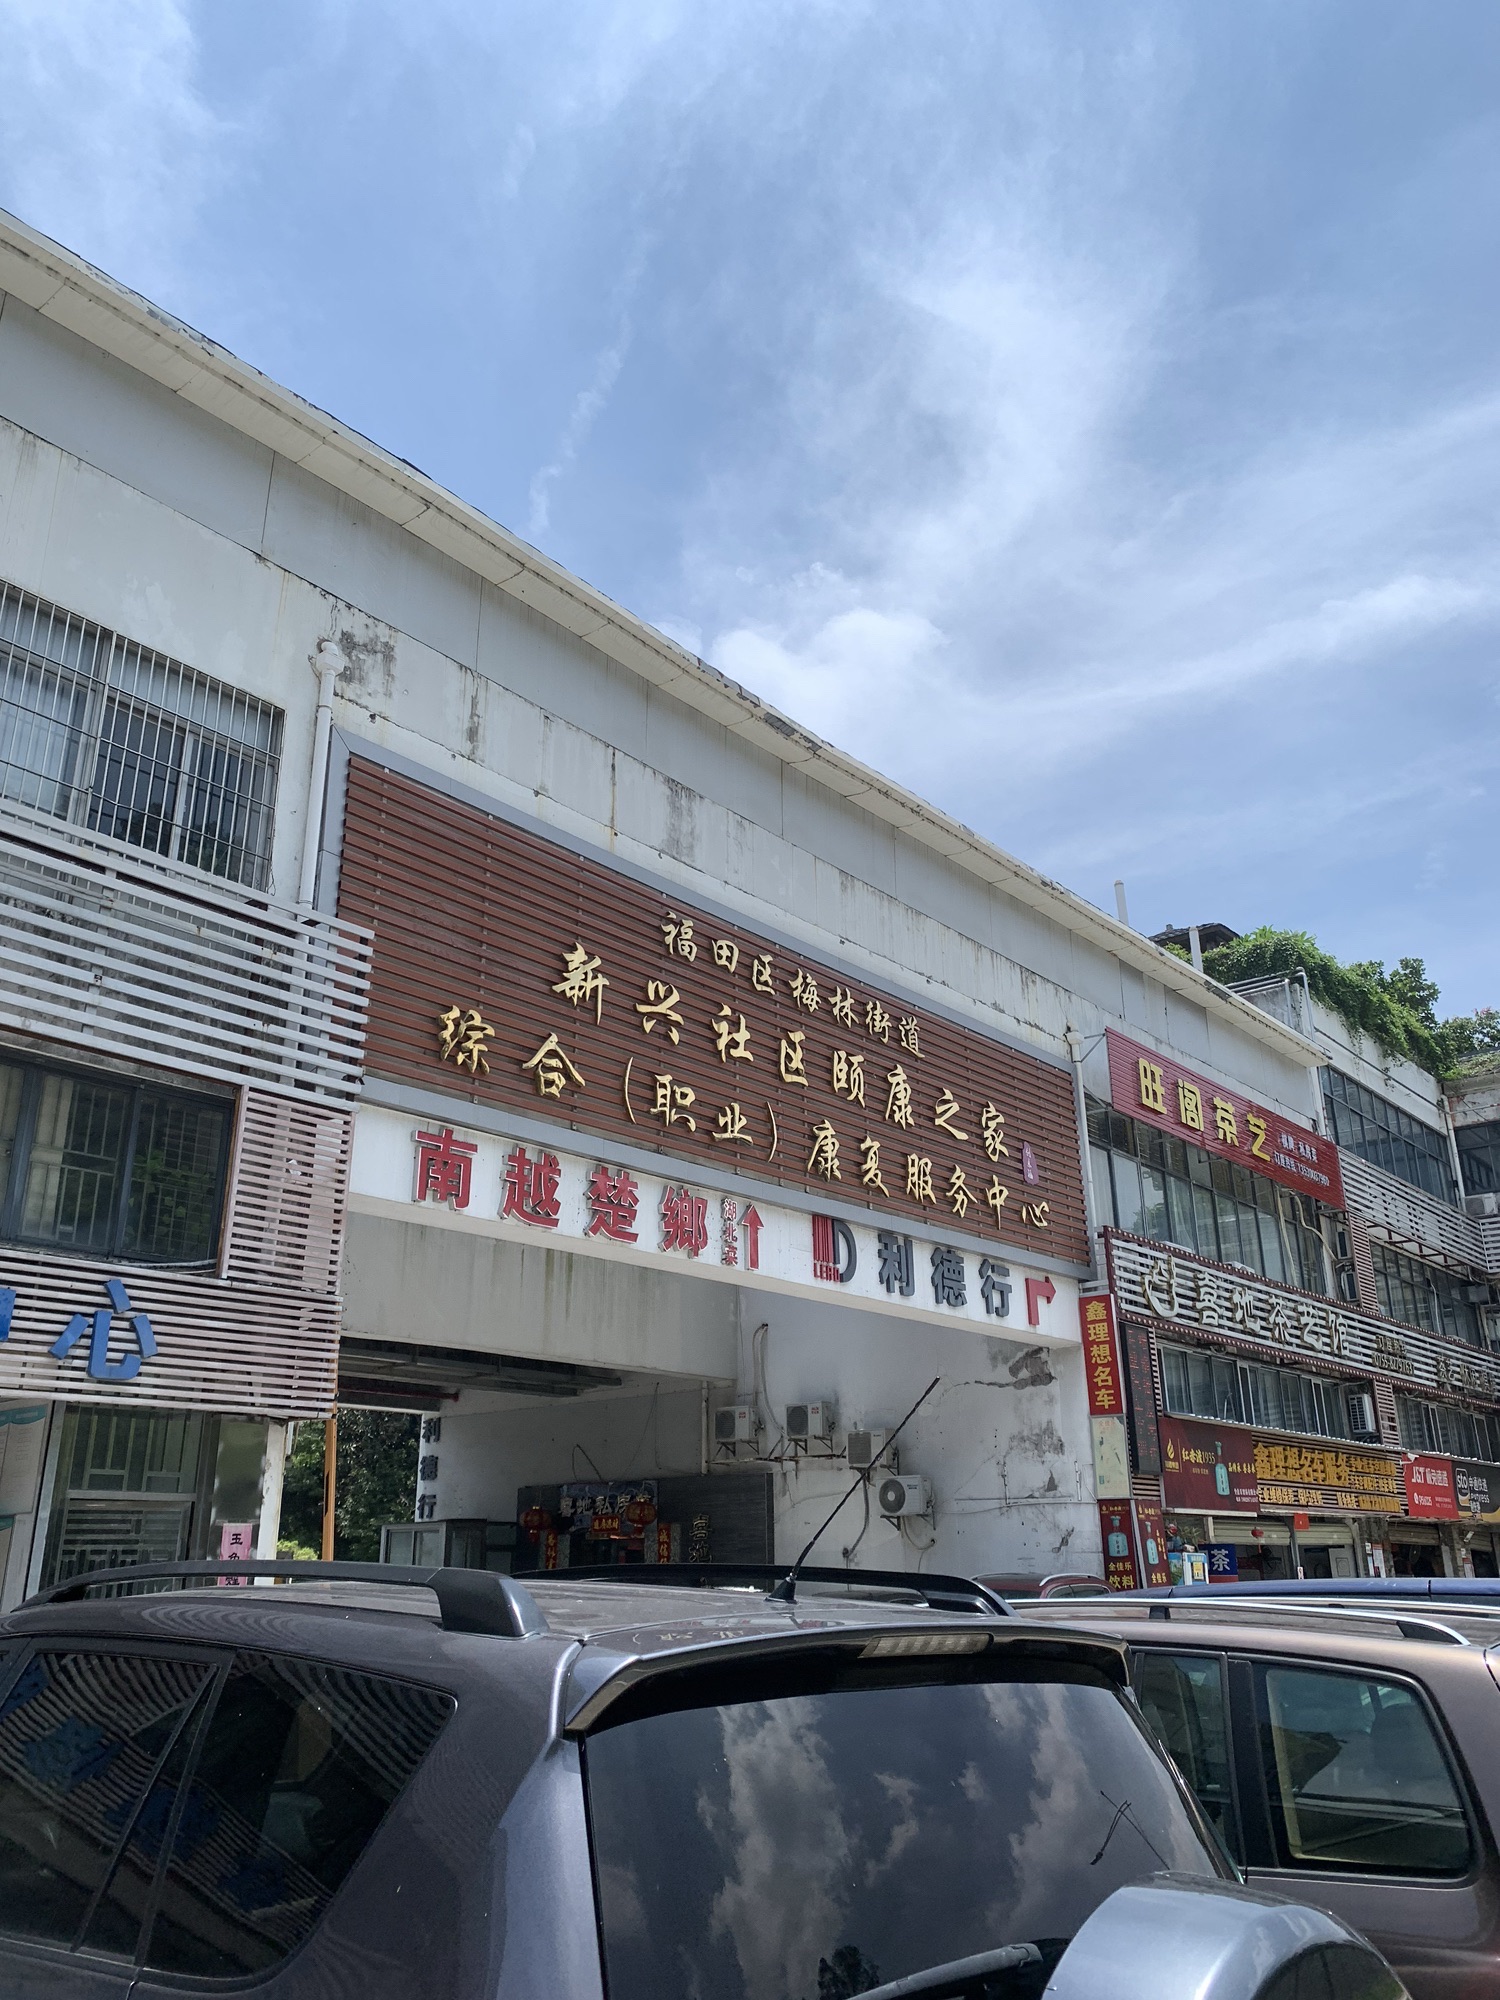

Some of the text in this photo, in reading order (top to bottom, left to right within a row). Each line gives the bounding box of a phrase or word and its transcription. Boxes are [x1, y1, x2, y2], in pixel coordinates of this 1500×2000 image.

[660, 910, 926, 1060] 福田区梅林街道
[551, 940, 1011, 1163] 新兴社区颐康之家
[411, 1126, 710, 1261] 南越楚鄉
[876, 1230, 1012, 1318] 利德行
[1194, 1270, 1351, 1357] 喜地茶艺馆
[1085, 1300, 1117, 1410] 鑫理想名车
[416, 1416, 442, 1521] 利德行
[1253, 1442, 1349, 1488] 鑫理想名车服务
[1108, 1574, 1135, 1589] 饮料
[1210, 1548, 1231, 1572] 茶
